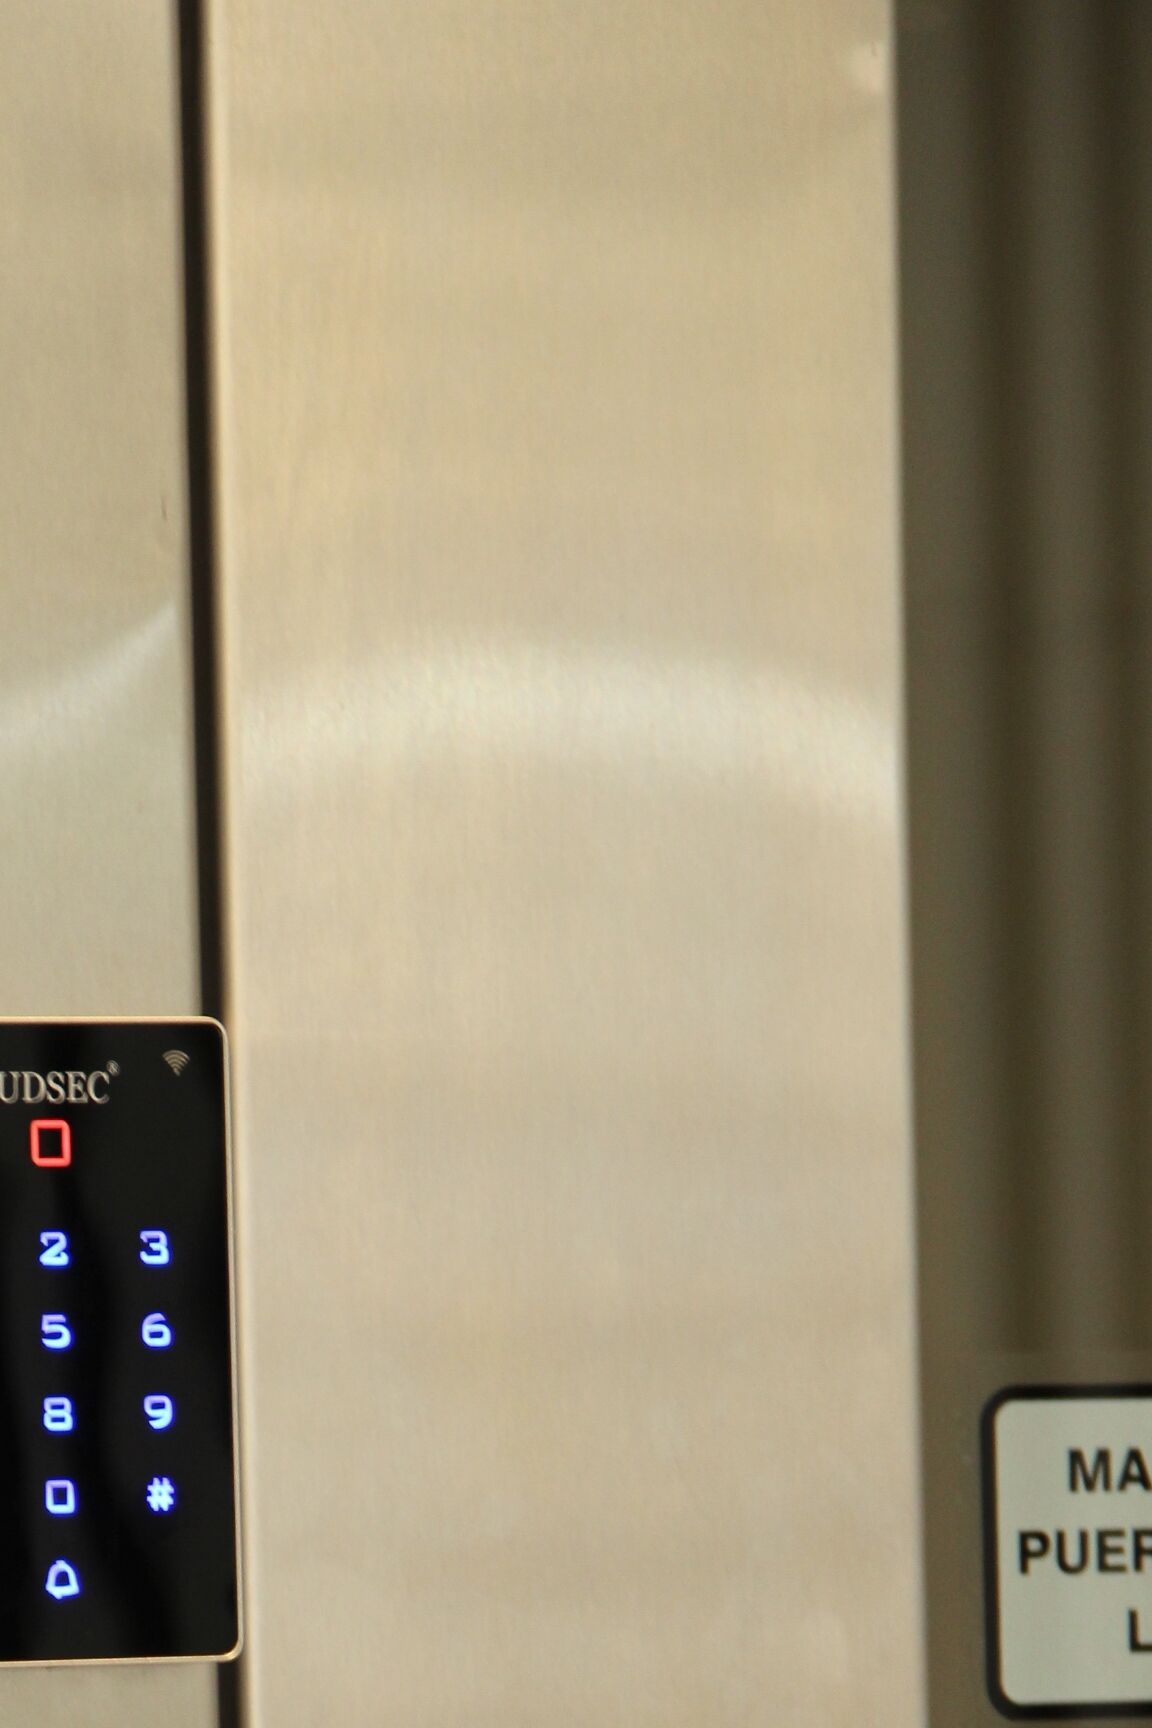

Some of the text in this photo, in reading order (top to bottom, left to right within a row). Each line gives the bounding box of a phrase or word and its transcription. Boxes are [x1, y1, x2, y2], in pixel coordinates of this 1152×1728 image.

[38, 1229, 72, 1269] 2
[139, 1229, 173, 1268] 3
[40, 1312, 74, 1352] 5
[140, 1311, 174, 1350] 6
[42, 1394, 76, 1434] 8
[142, 1393, 176, 1432] 9
[44, 1476, 79, 1517] 0
[145, 1475, 176, 1514] #
